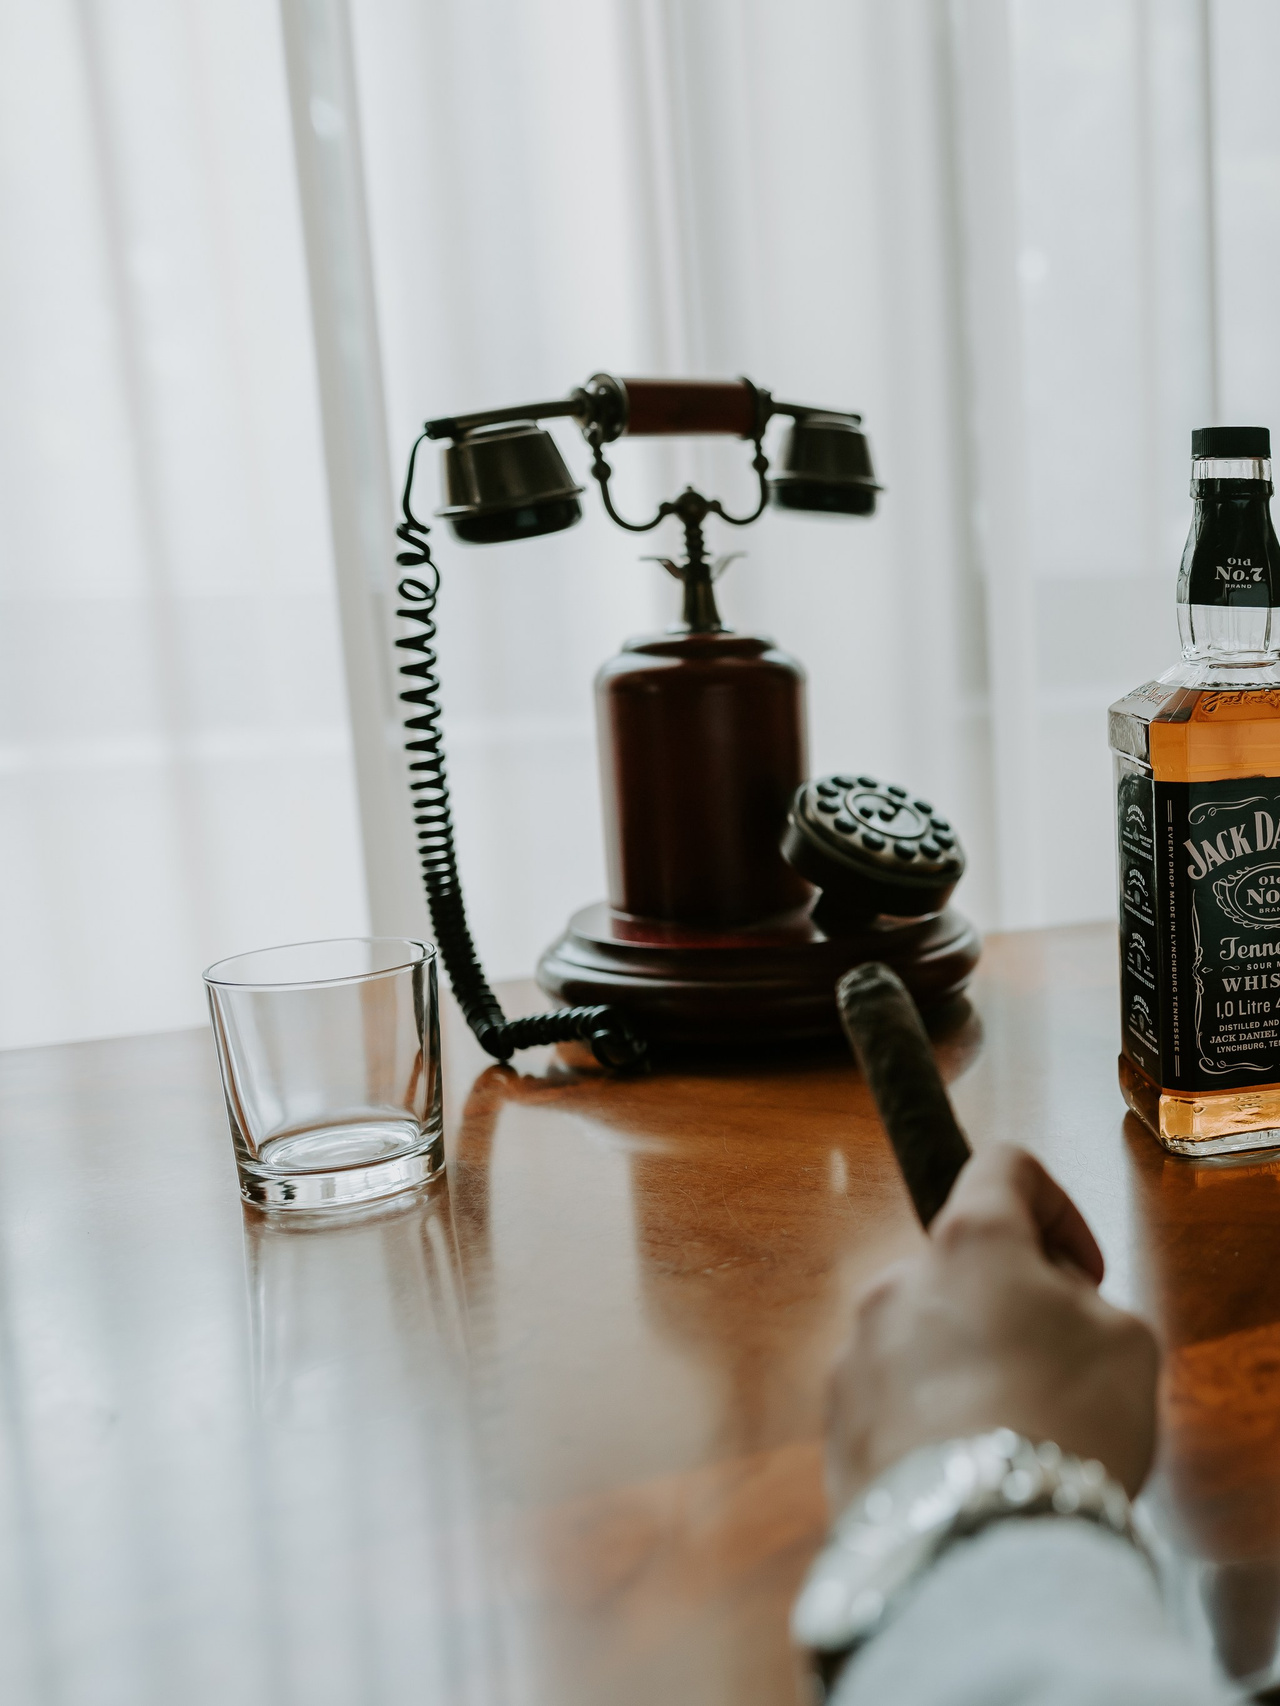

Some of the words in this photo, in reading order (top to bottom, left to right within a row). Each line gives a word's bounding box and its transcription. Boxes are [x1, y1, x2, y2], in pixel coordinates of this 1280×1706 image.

[1227, 557, 1251, 566] Old
[1214, 566, 1263, 581] No.7
[1183, 823, 1253, 880] JACK
[1170, 921, 1176, 931] IN
[1170, 934, 1178, 993] LYNCHBURG
[1246, 962, 1272, 971] SOUR
[1239, 1000, 1271, 1016] Litre
[1219, 1021, 1260, 1032] DISTILLED
[1262, 1019, 1279, 1027] AND
[1209, 1034, 1236, 1044] JACK
[1239, 1030, 1278, 1041] DANIEL
[1216, 1042, 1267, 1054] LYNCHBURG,
